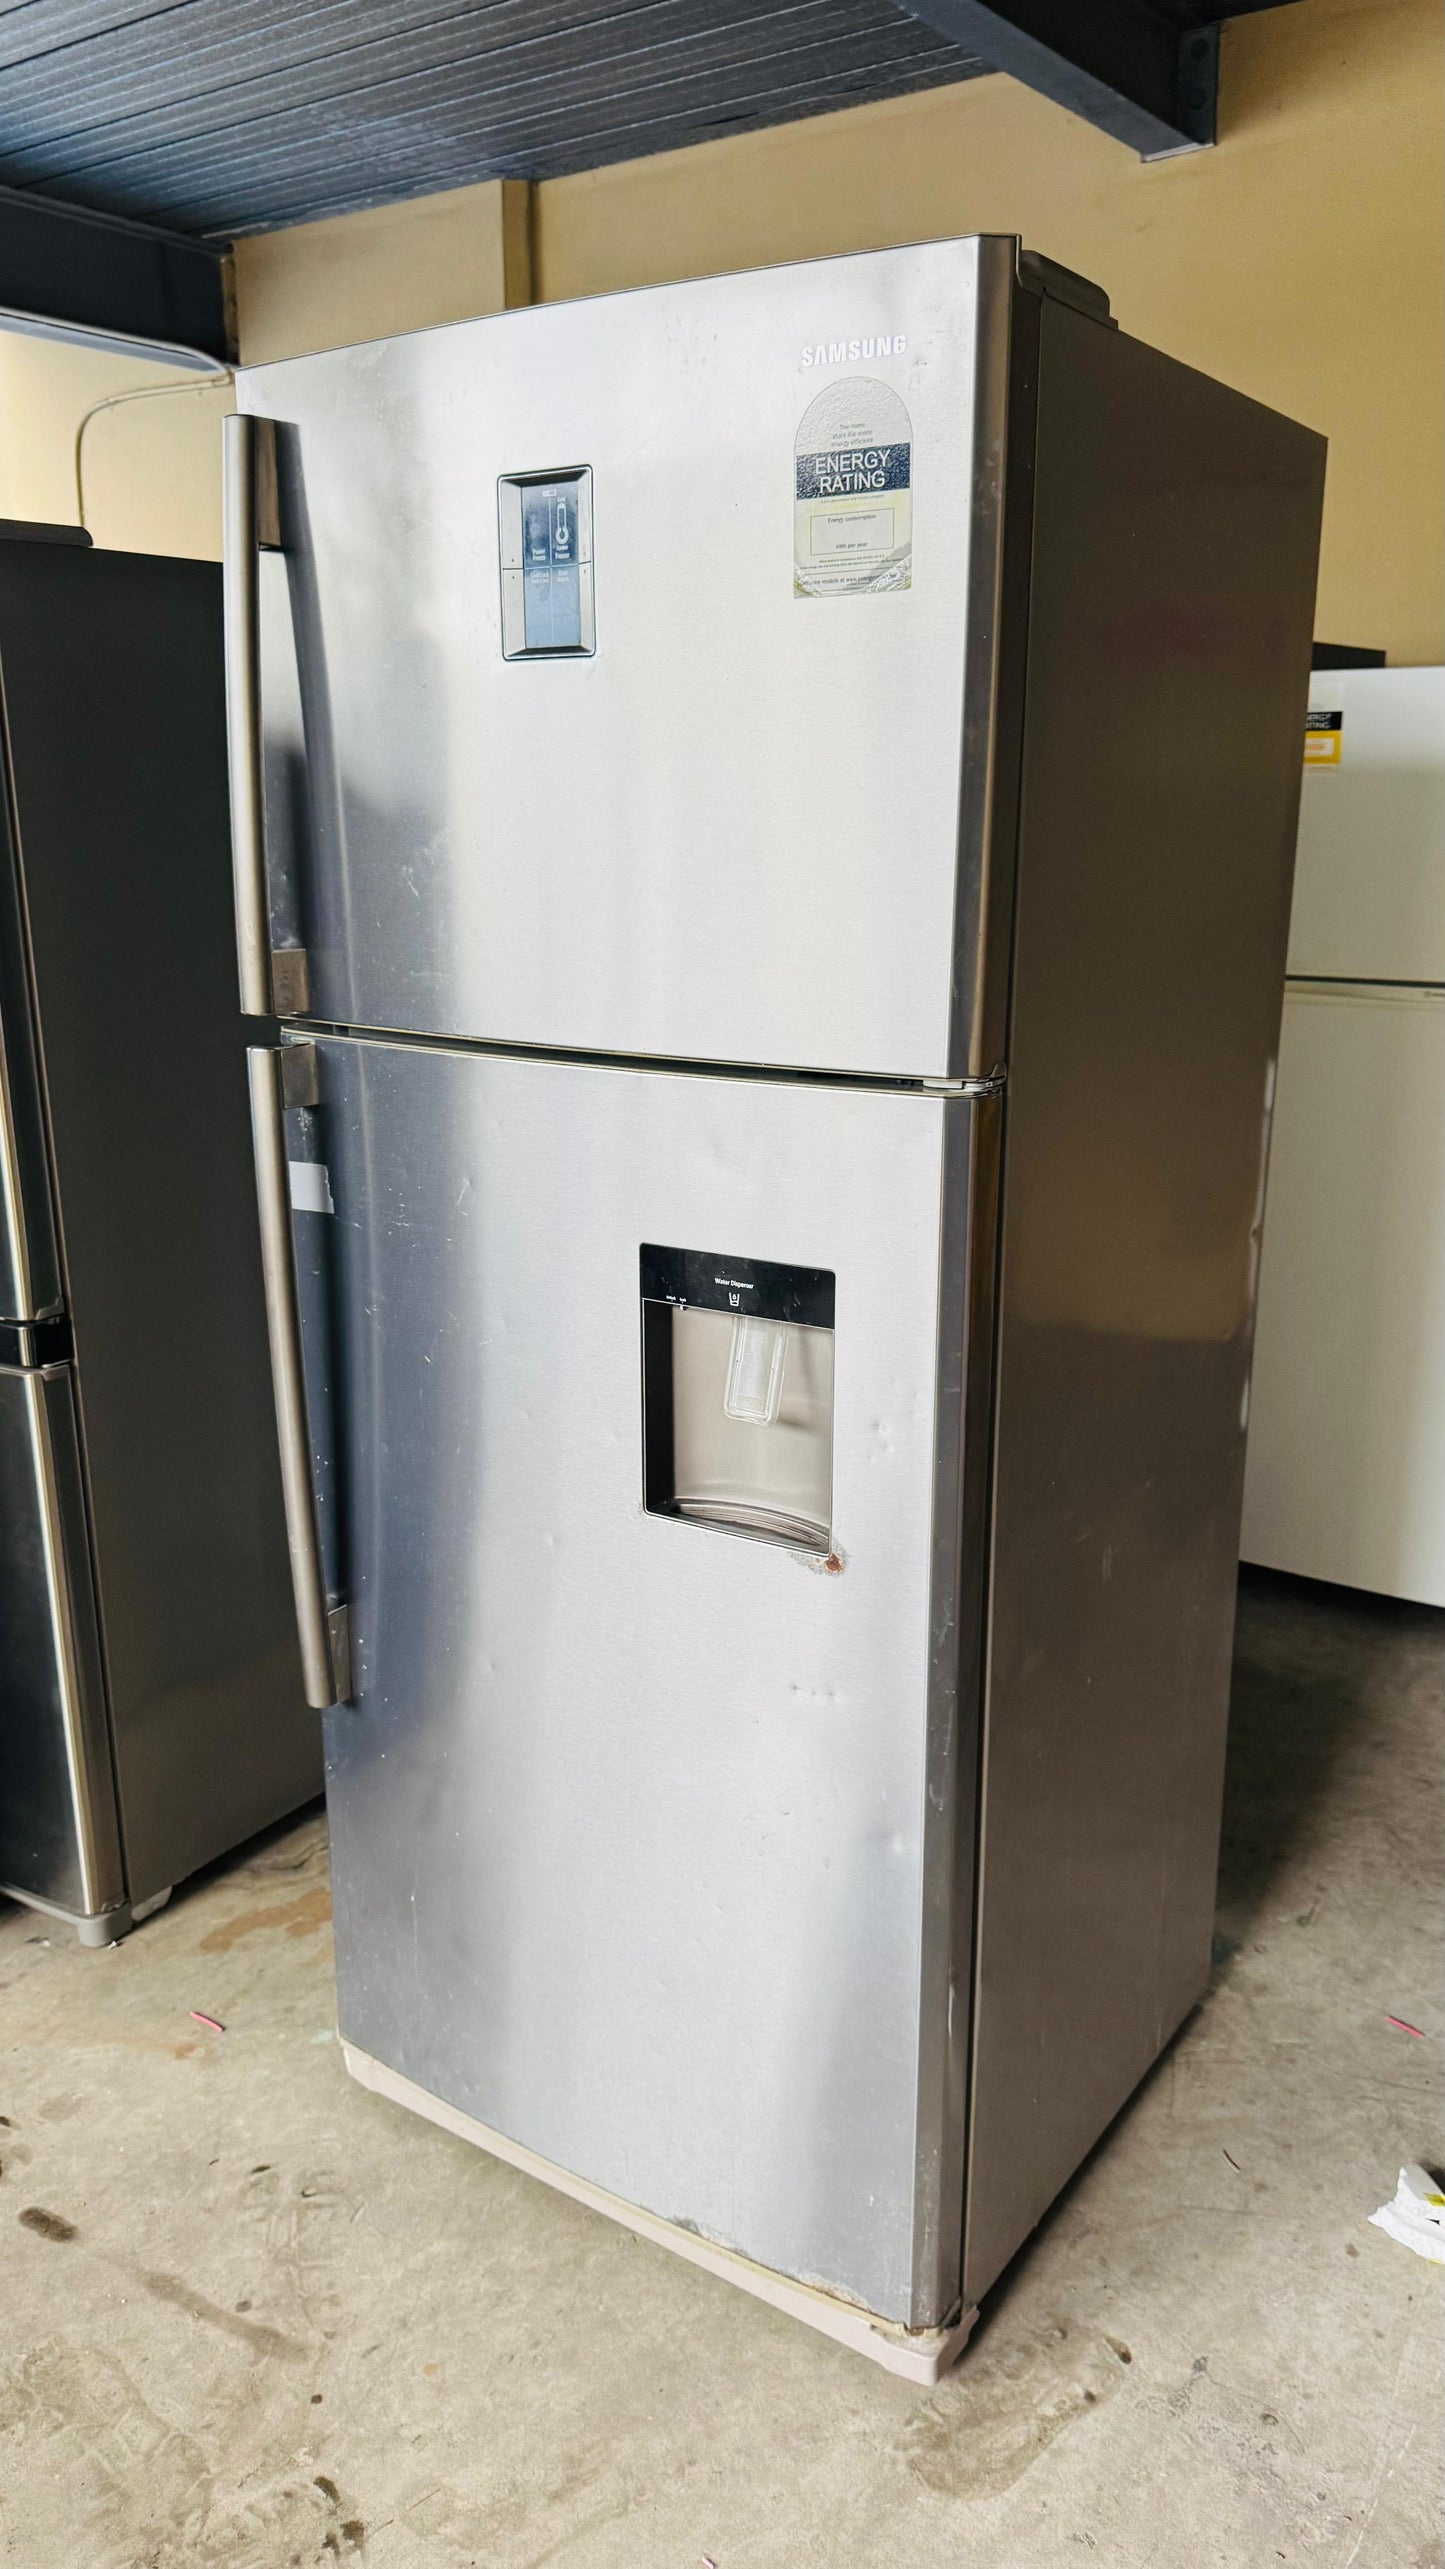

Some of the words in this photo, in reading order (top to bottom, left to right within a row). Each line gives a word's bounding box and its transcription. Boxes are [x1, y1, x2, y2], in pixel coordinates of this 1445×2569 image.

[801, 334, 906, 367] SAMSUNG
[815, 449, 890, 474] ENERGY
[819, 470, 885, 494] RATING
[714, 1277, 730, 1286] Water
[730, 1280, 755, 1290] Dispenser
